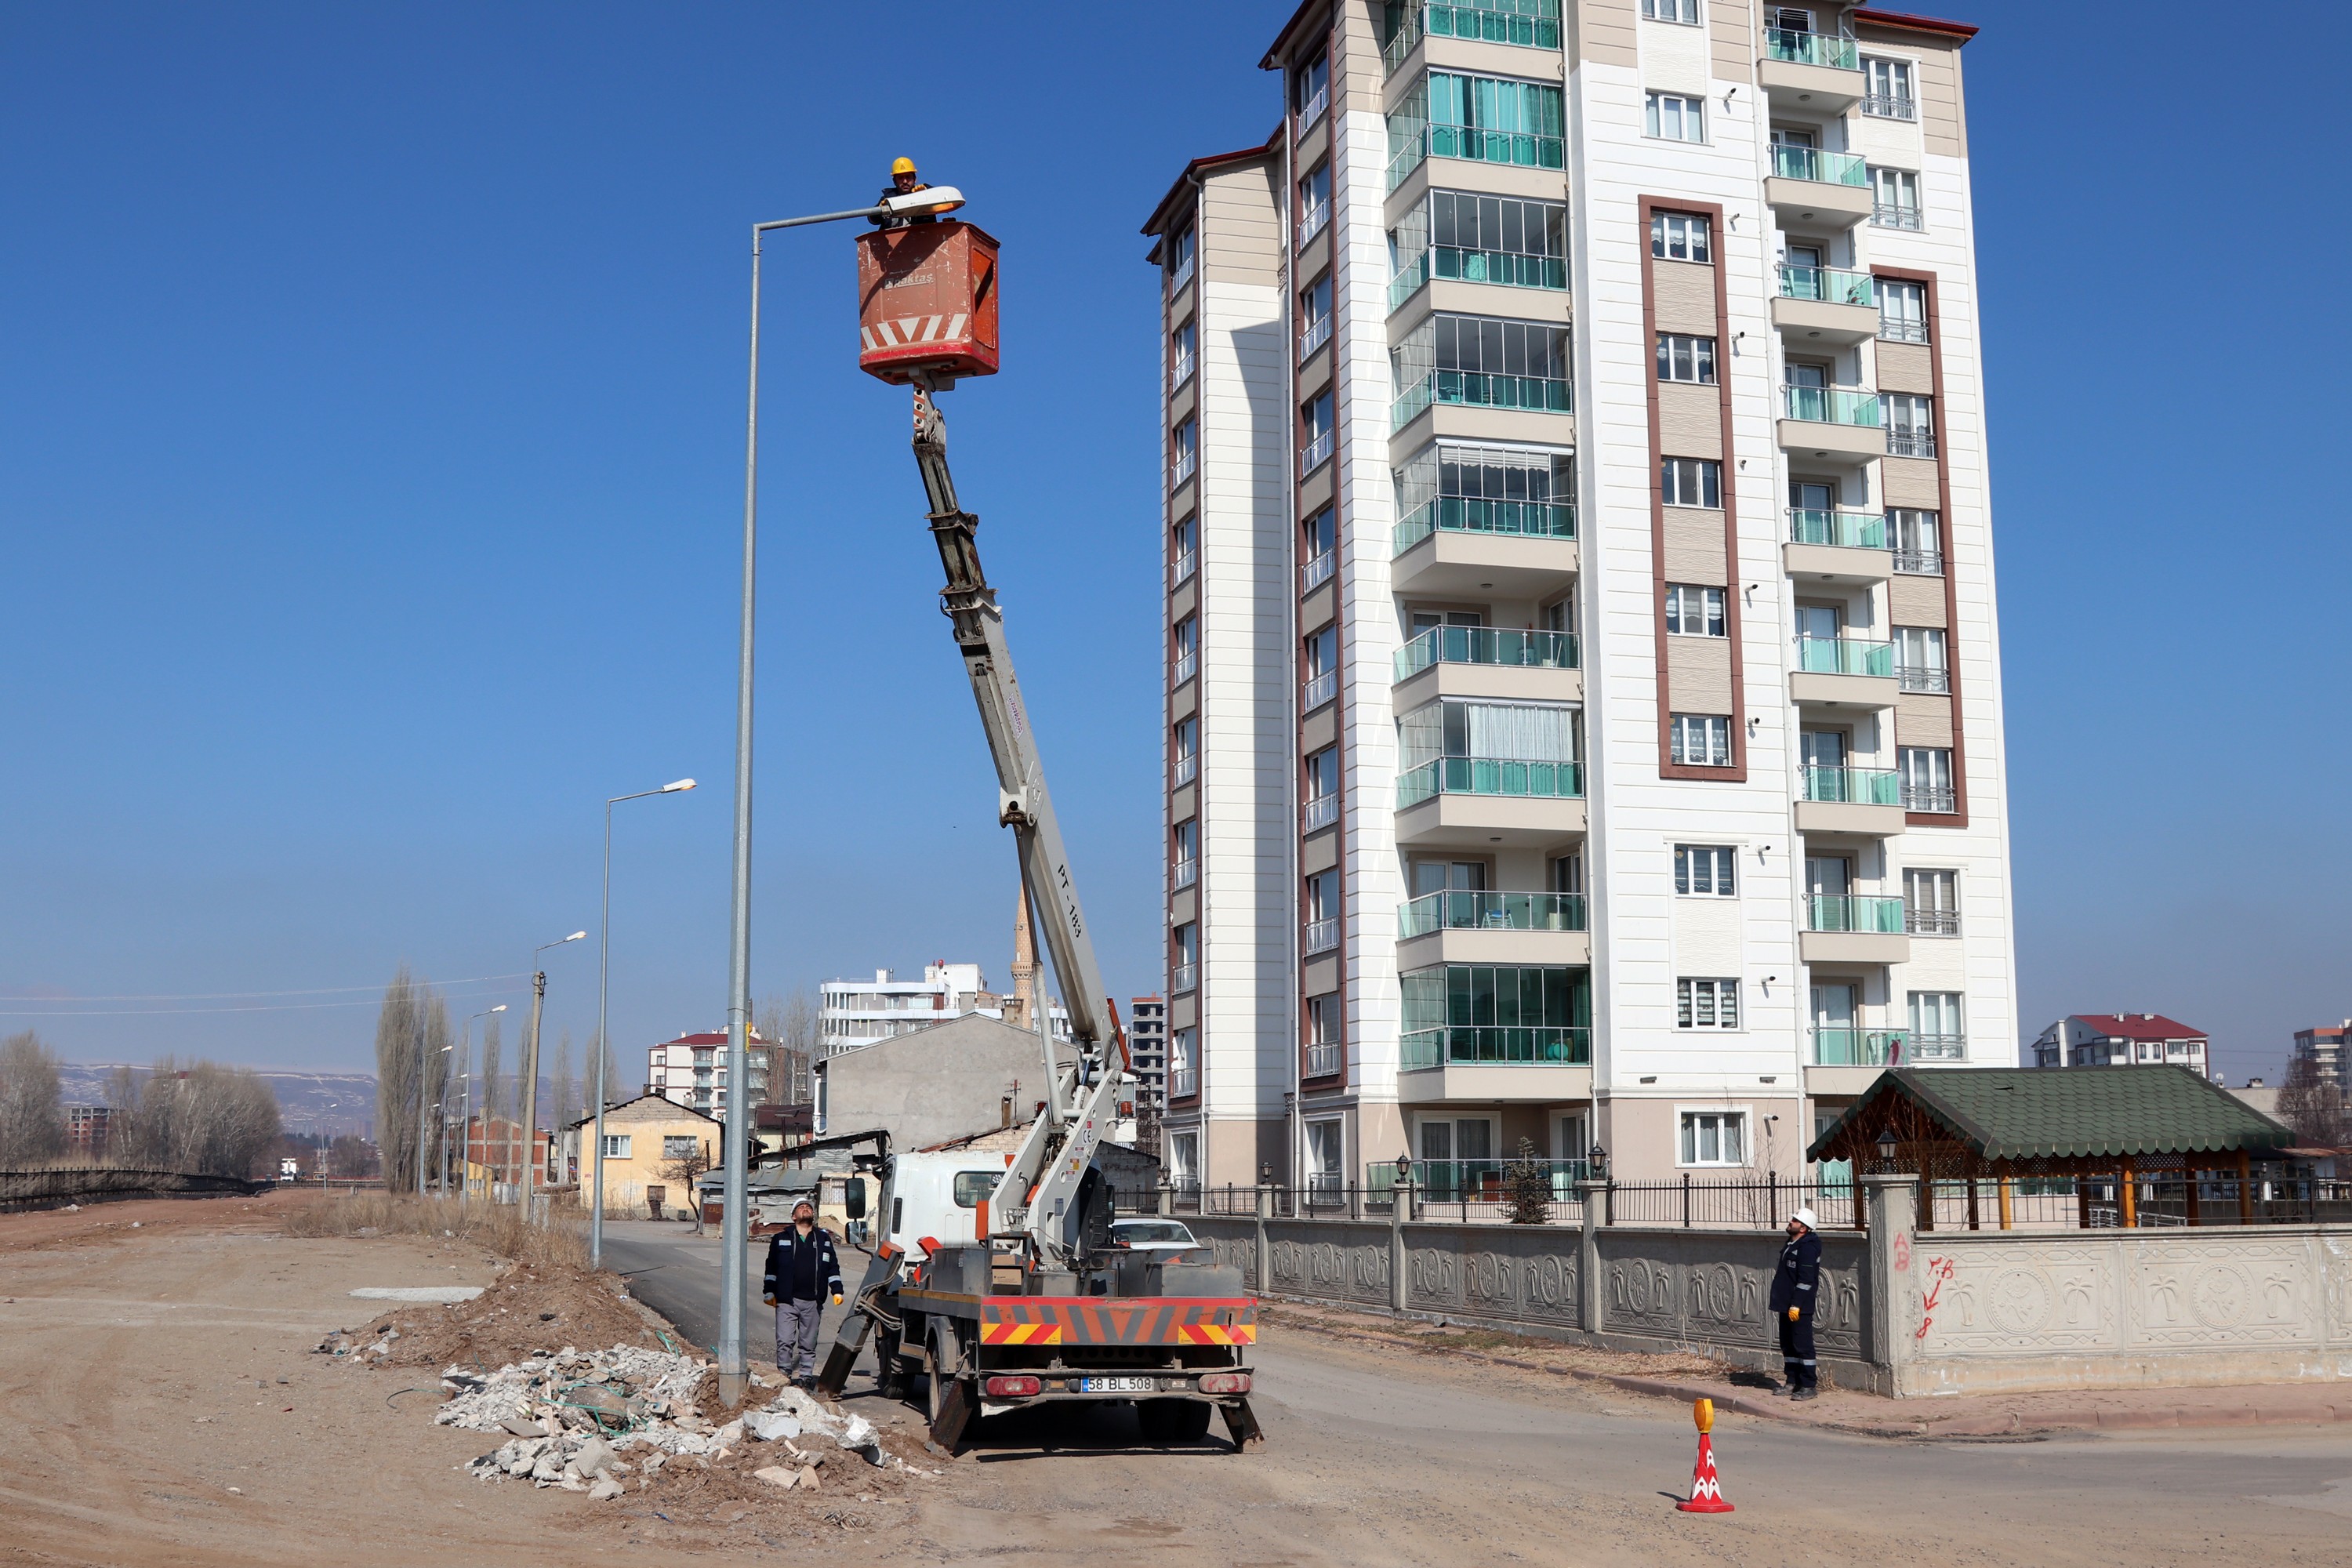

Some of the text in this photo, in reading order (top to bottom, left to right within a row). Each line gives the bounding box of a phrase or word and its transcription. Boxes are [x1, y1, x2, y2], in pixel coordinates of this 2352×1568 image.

[1058, 864, 1069, 889] PT
[1069, 904, 1082, 938] 183
[1088, 1378, 1103, 1390] 58
[1109, 1378, 1126, 1390] BL
[1129, 1378, 1152, 1390] 508
